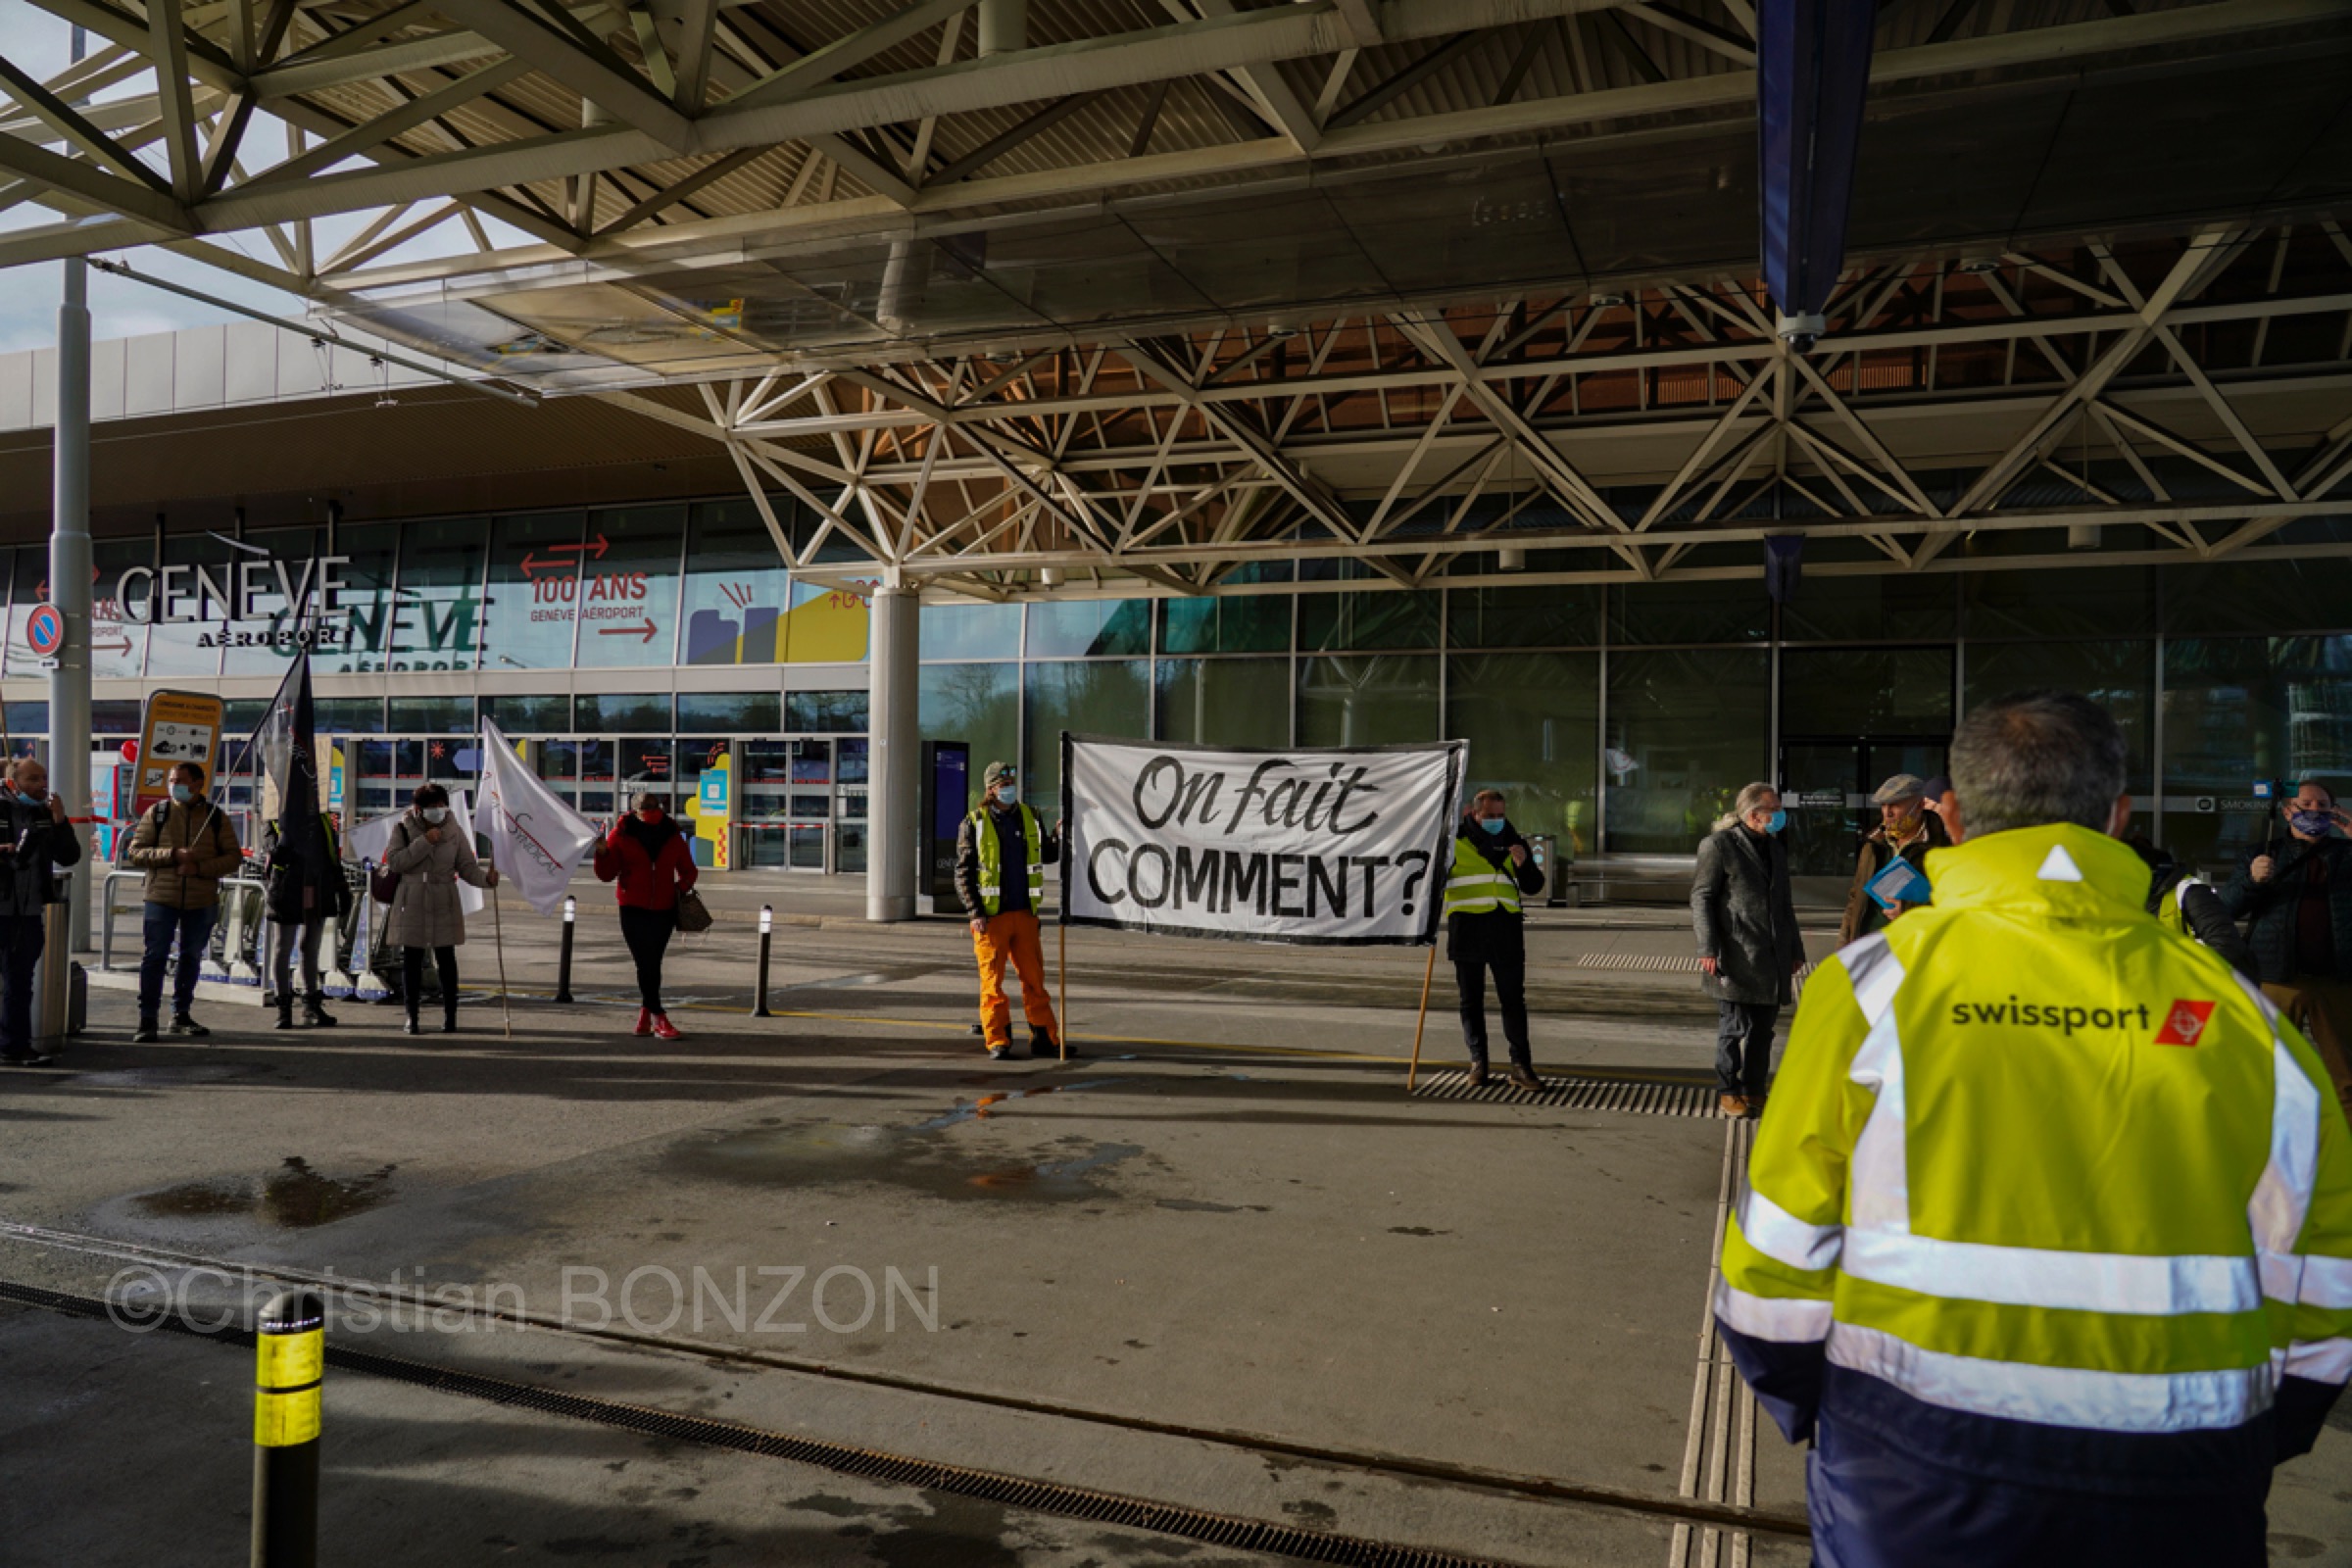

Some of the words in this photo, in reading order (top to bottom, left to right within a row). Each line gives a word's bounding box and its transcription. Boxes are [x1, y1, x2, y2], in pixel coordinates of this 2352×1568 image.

[116, 530, 353, 624] GENÈVE
[532, 574, 576, 604] 100
[588, 571, 648, 601] ANS
[198, 625, 354, 648] AÉROPORT
[1132, 756, 1225, 830] On
[1224, 760, 1379, 835] fait
[1088, 839, 1431, 918] COMMENT?
[1952, 994, 2150, 1036] swissport
